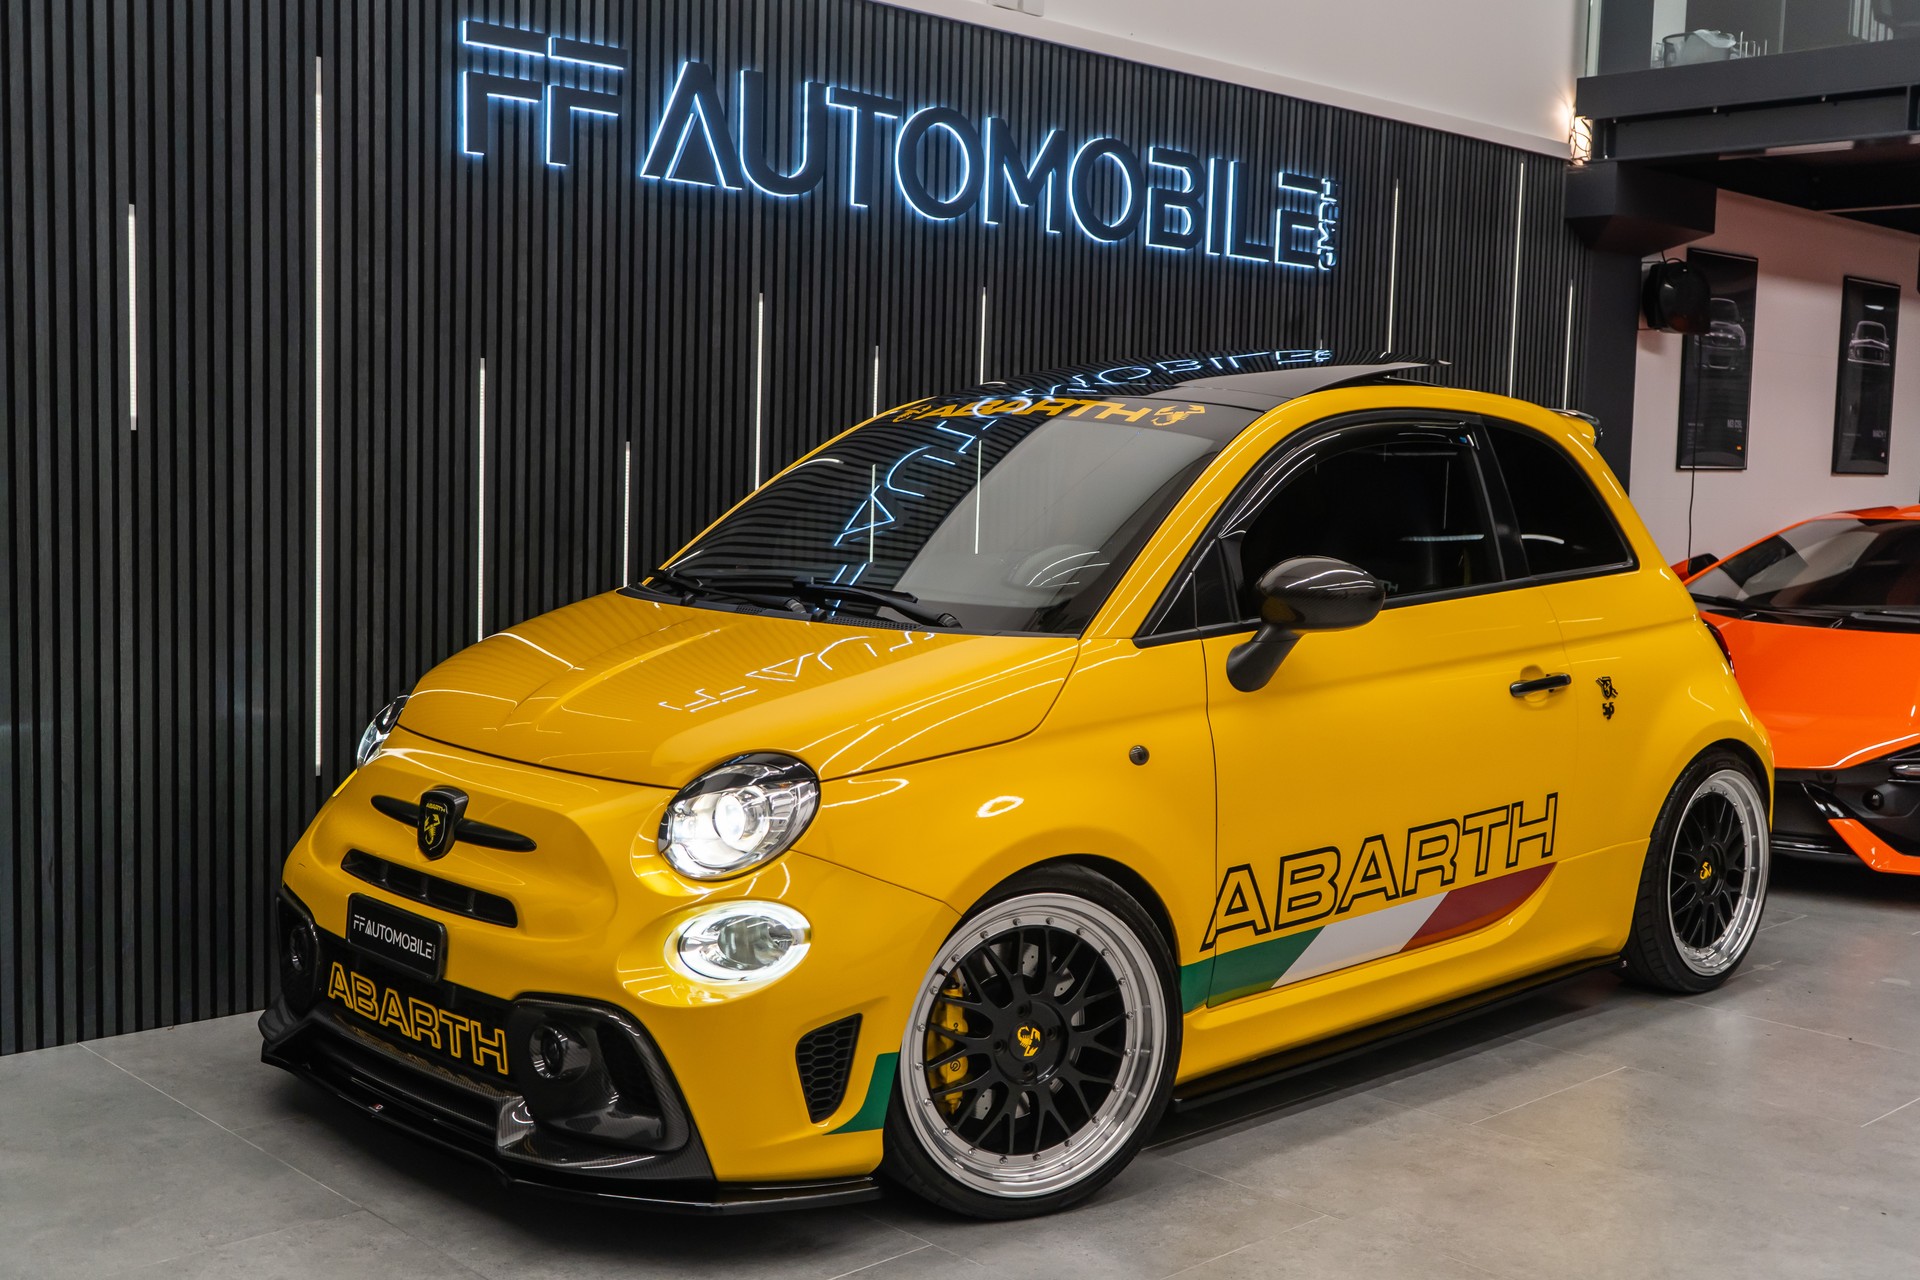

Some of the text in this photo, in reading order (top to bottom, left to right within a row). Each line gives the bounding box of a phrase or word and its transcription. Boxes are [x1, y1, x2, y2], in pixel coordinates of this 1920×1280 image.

[640, 61, 1322, 269] AUTOMOBILE
[913, 397, 1152, 422] ABARTH
[1199, 792, 1558, 952] ABARTH
[328, 962, 509, 1075] ABARTH
